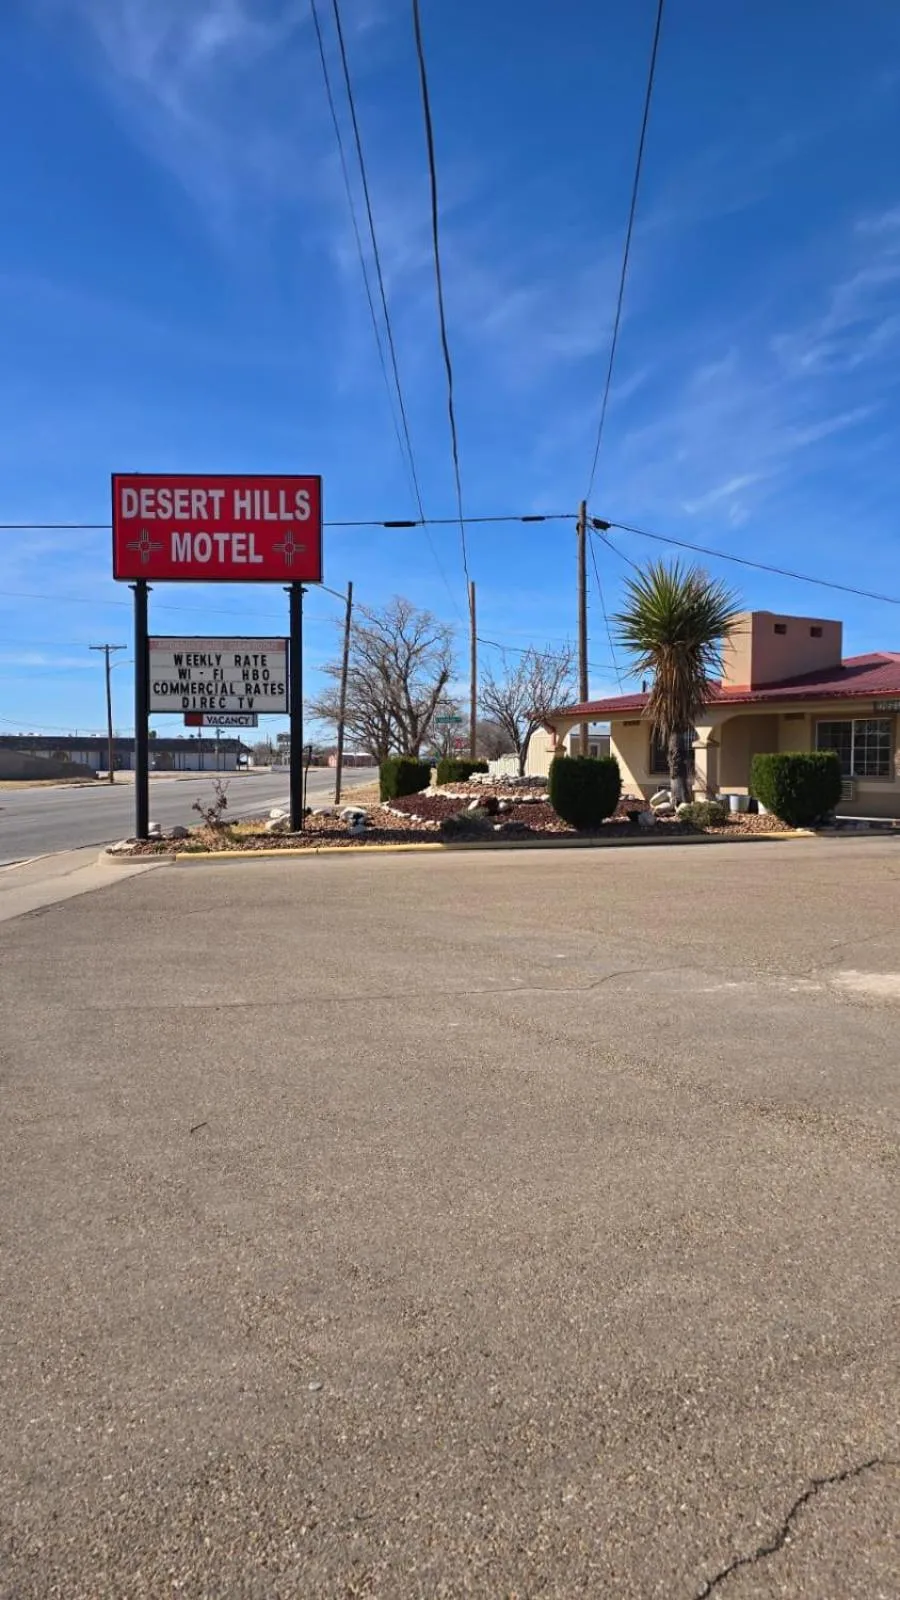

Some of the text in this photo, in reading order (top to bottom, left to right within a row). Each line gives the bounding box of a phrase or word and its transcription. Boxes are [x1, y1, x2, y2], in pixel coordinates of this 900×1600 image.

[121, 488, 311, 521] DESERT HILLS
[171, 532, 263, 563] MOTEL
[173, 654, 267, 667] WEEKLY RATE
[242, 668, 270, 681] HBO
[153, 682, 285, 695] COMMERCIAL RATES
[182, 696, 255, 709] DIREC TV
[206, 716, 251, 725] VACANCY
